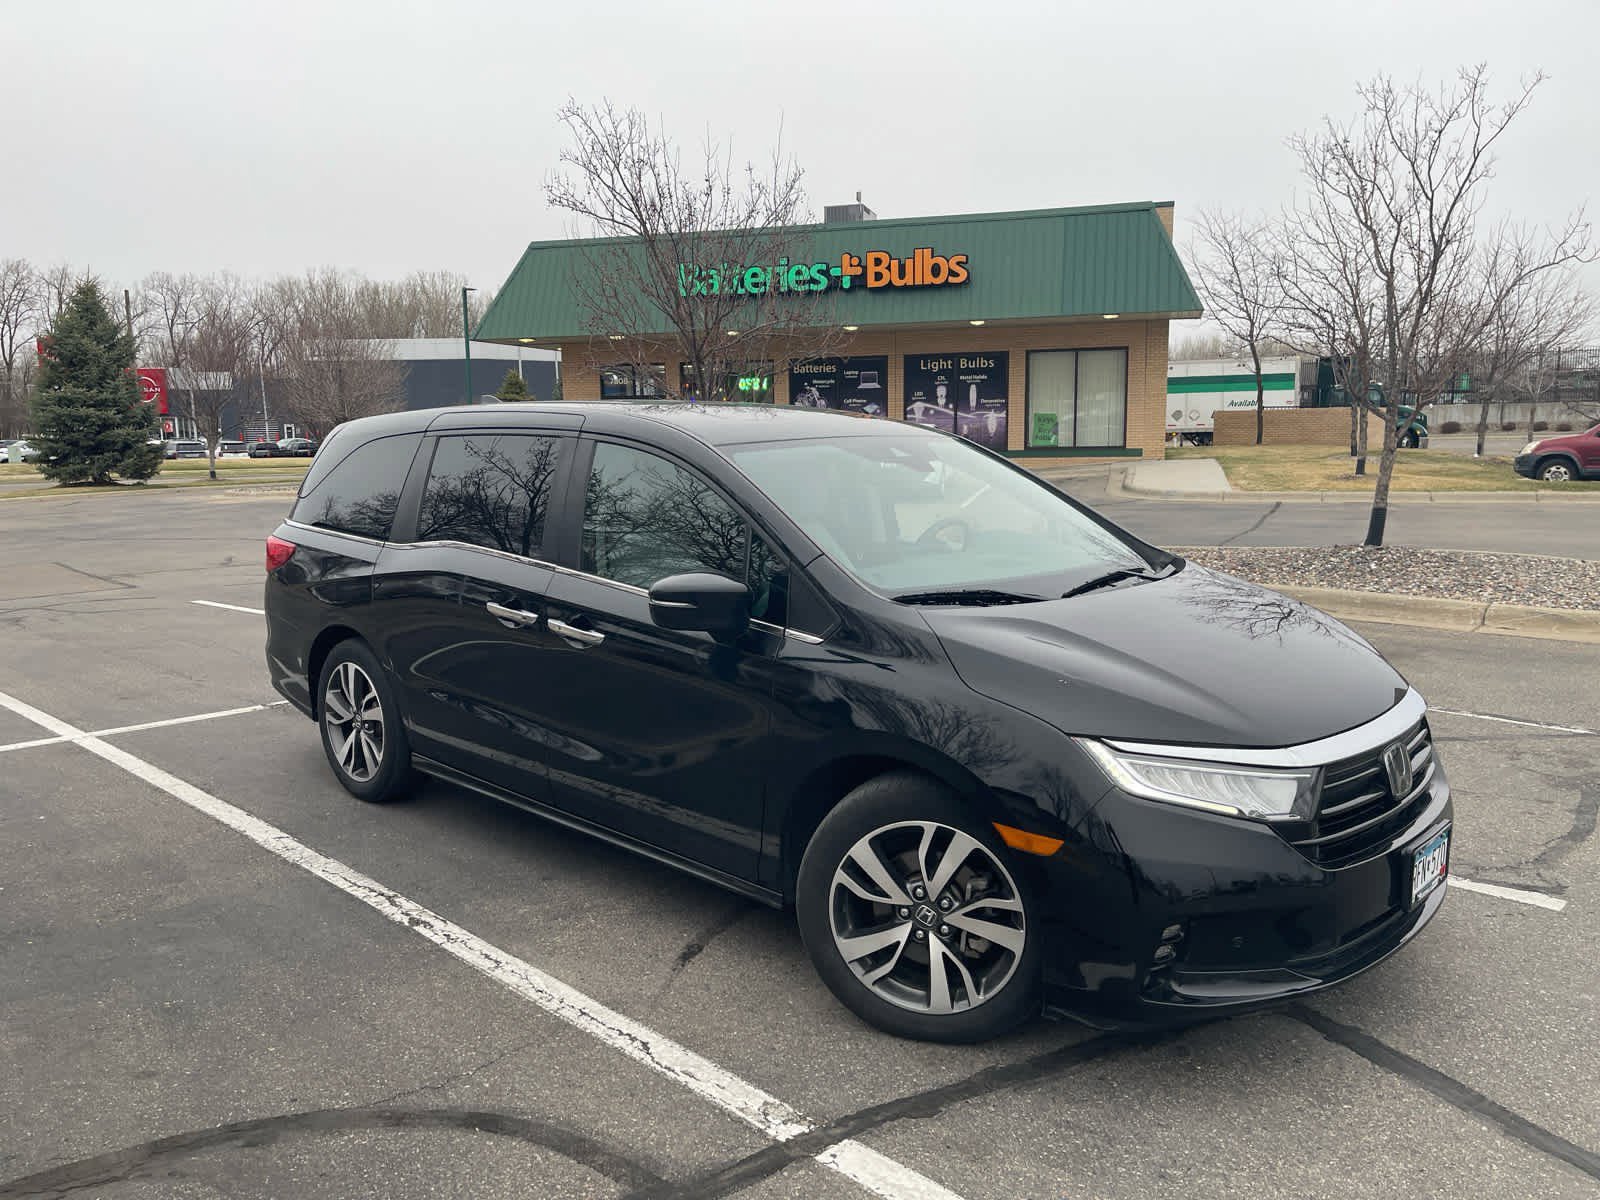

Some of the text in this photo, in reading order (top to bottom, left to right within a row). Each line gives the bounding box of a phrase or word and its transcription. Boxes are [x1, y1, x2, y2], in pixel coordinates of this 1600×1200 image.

[866, 247, 969, 288] Bulbs
[793, 363, 837, 374] Batteries
[920, 357, 995, 372] Light Bulbs
[1227, 399, 1258, 407] Availab
